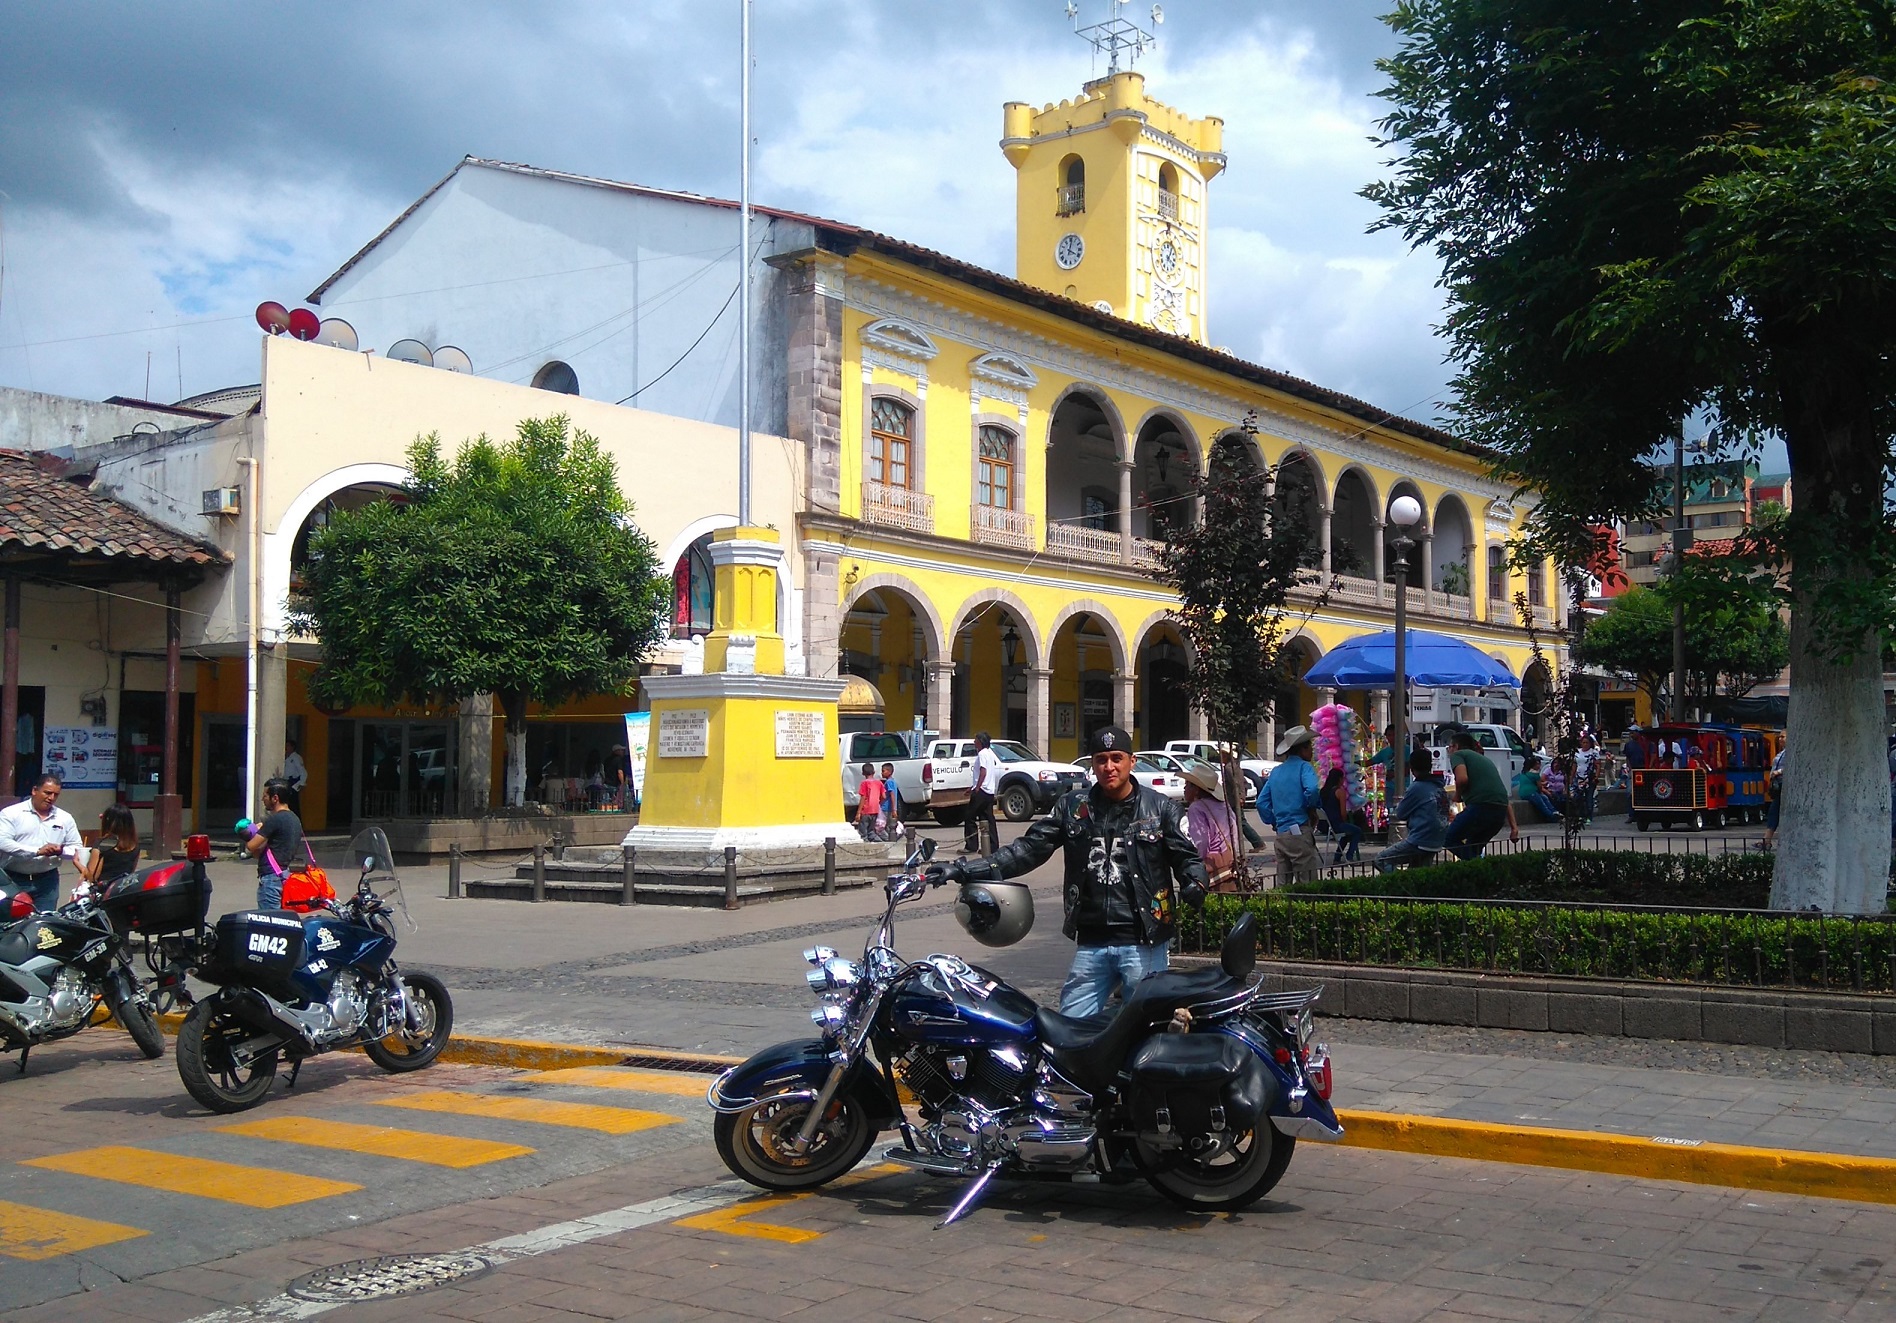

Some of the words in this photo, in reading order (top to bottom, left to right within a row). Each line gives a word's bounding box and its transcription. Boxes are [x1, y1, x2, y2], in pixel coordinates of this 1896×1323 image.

[933, 766, 963, 774] VEHICULO
[247, 913, 270, 923] POLICIA
[271, 917, 302, 928] MUNICIPAL
[249, 933, 288, 955] GM42
[308, 959, 329, 974] GM-42
